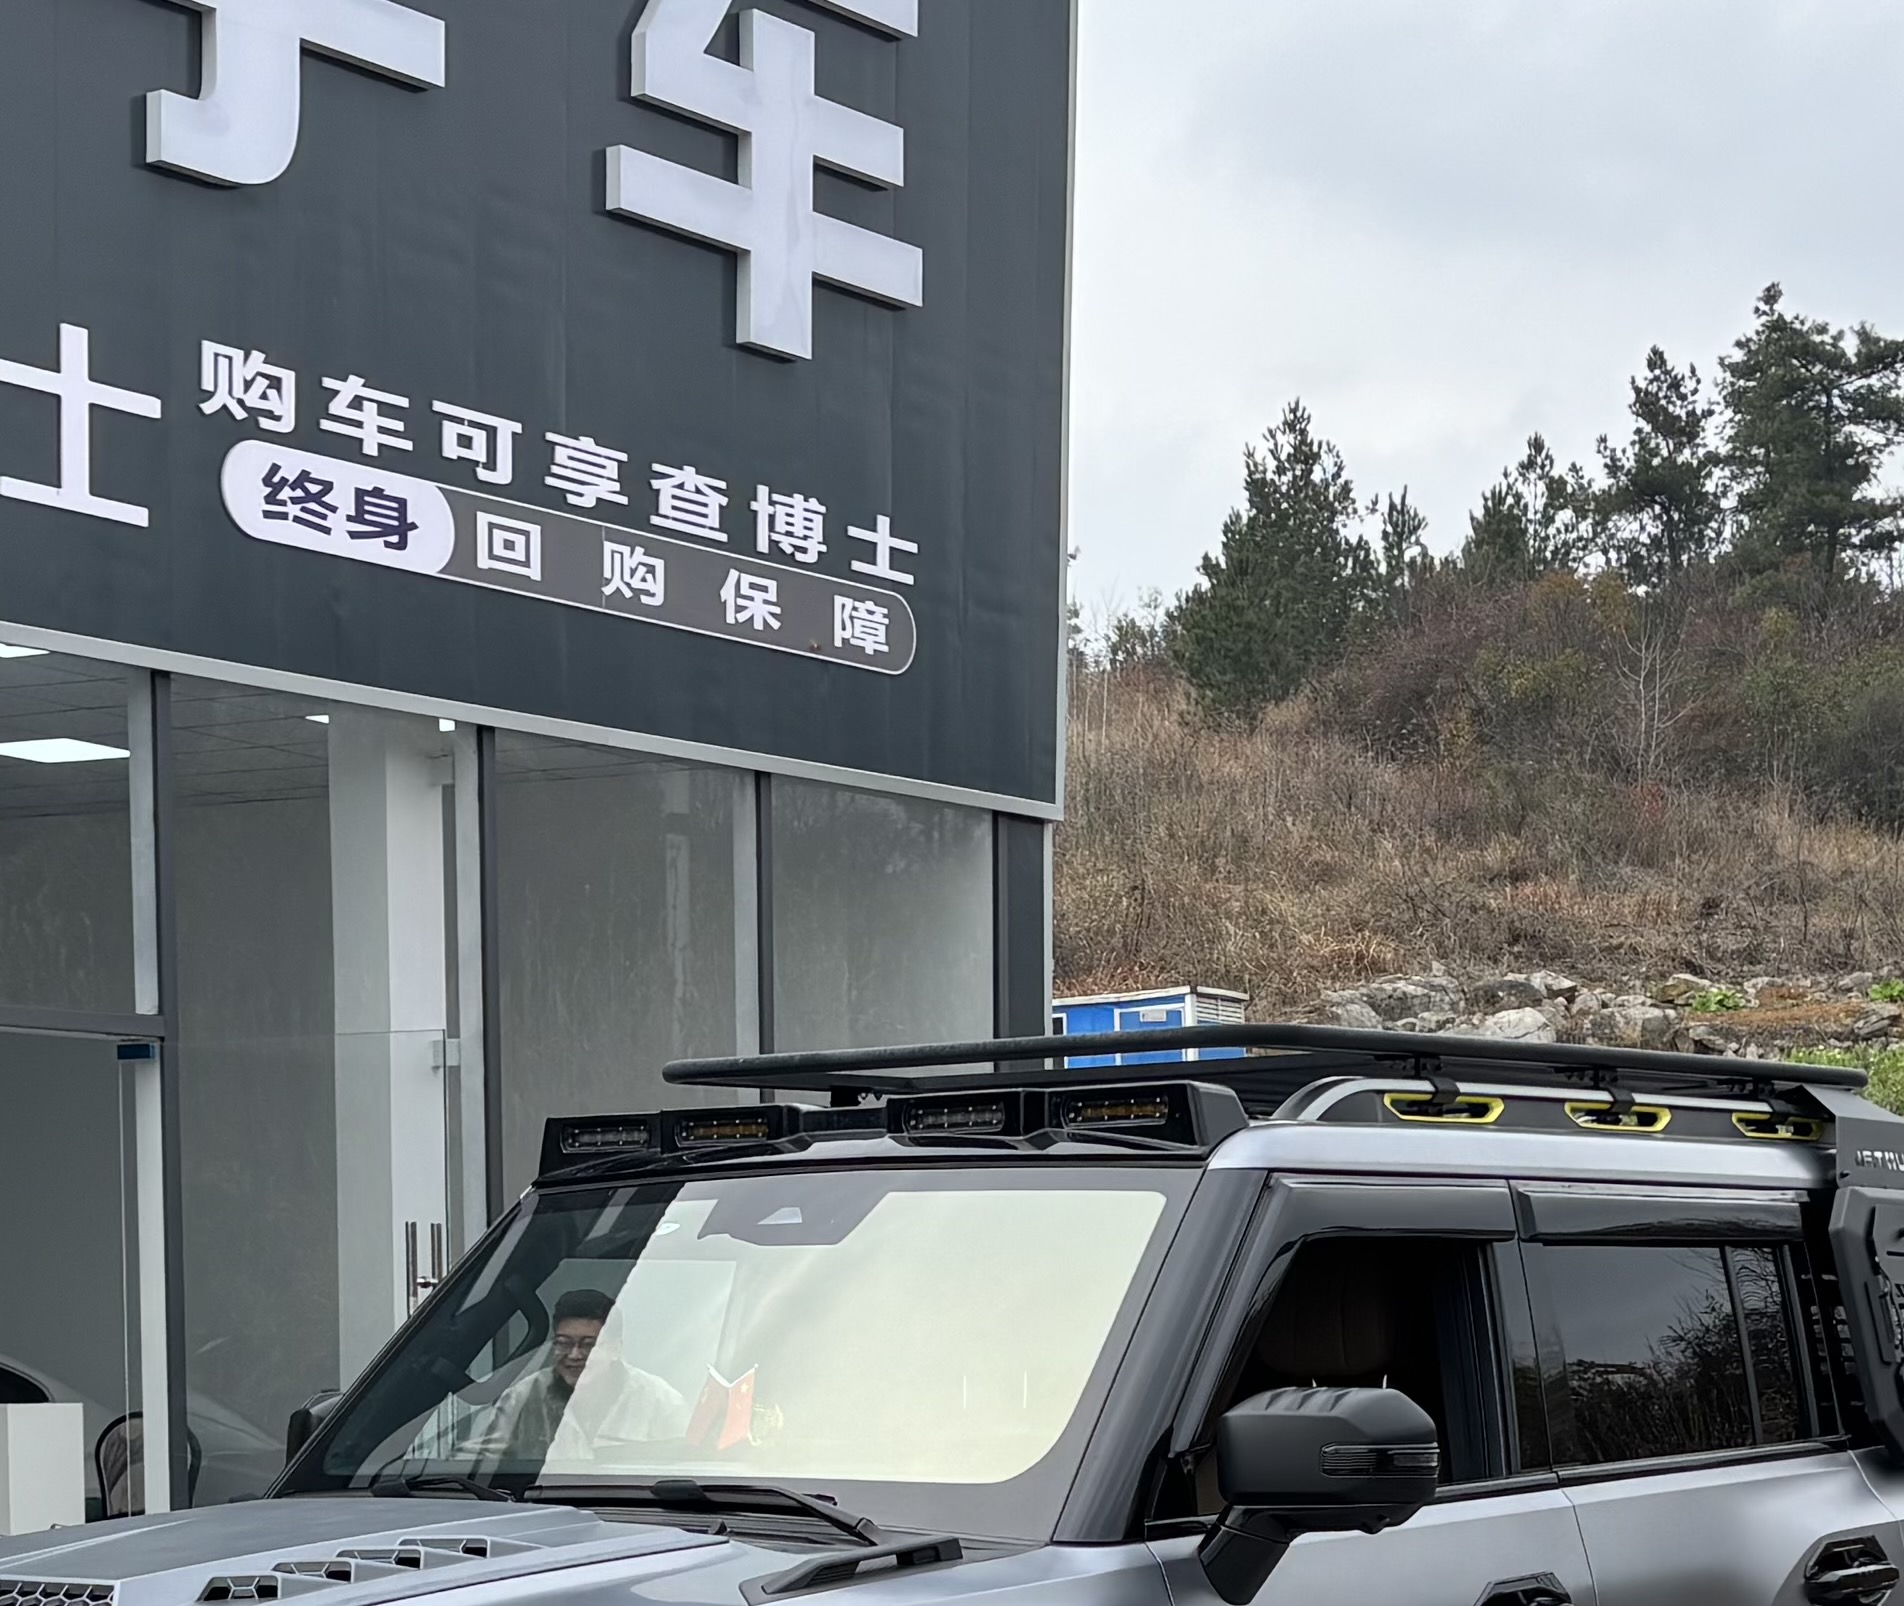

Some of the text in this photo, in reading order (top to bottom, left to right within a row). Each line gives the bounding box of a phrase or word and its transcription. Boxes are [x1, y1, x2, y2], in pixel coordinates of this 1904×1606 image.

[198, 338, 920, 586] 购车可享查博士
[259, 461, 891, 656] 终身 回购保障
